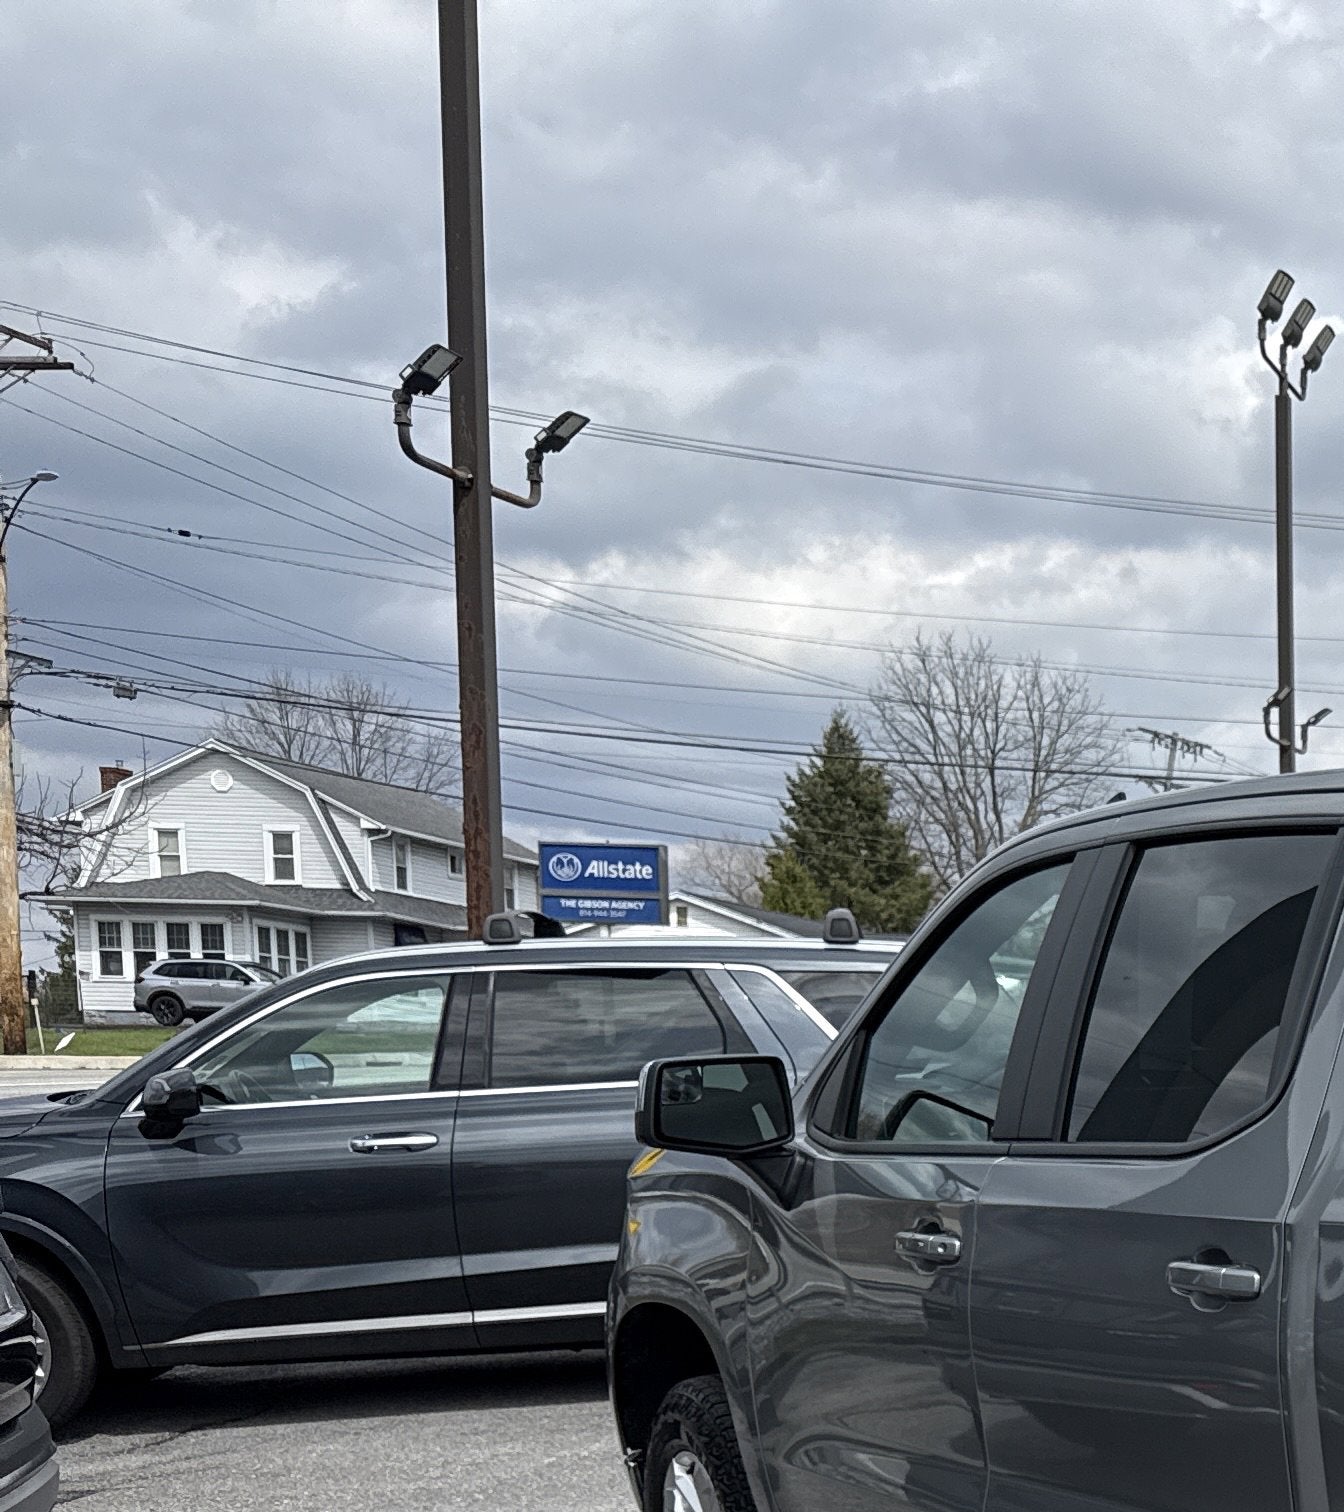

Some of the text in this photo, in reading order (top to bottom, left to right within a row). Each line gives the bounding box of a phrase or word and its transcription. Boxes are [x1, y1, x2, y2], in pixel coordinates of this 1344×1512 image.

[584, 860, 653, 879] Allstate
[560, 899, 646, 910] THE GIBSON AGENCY
